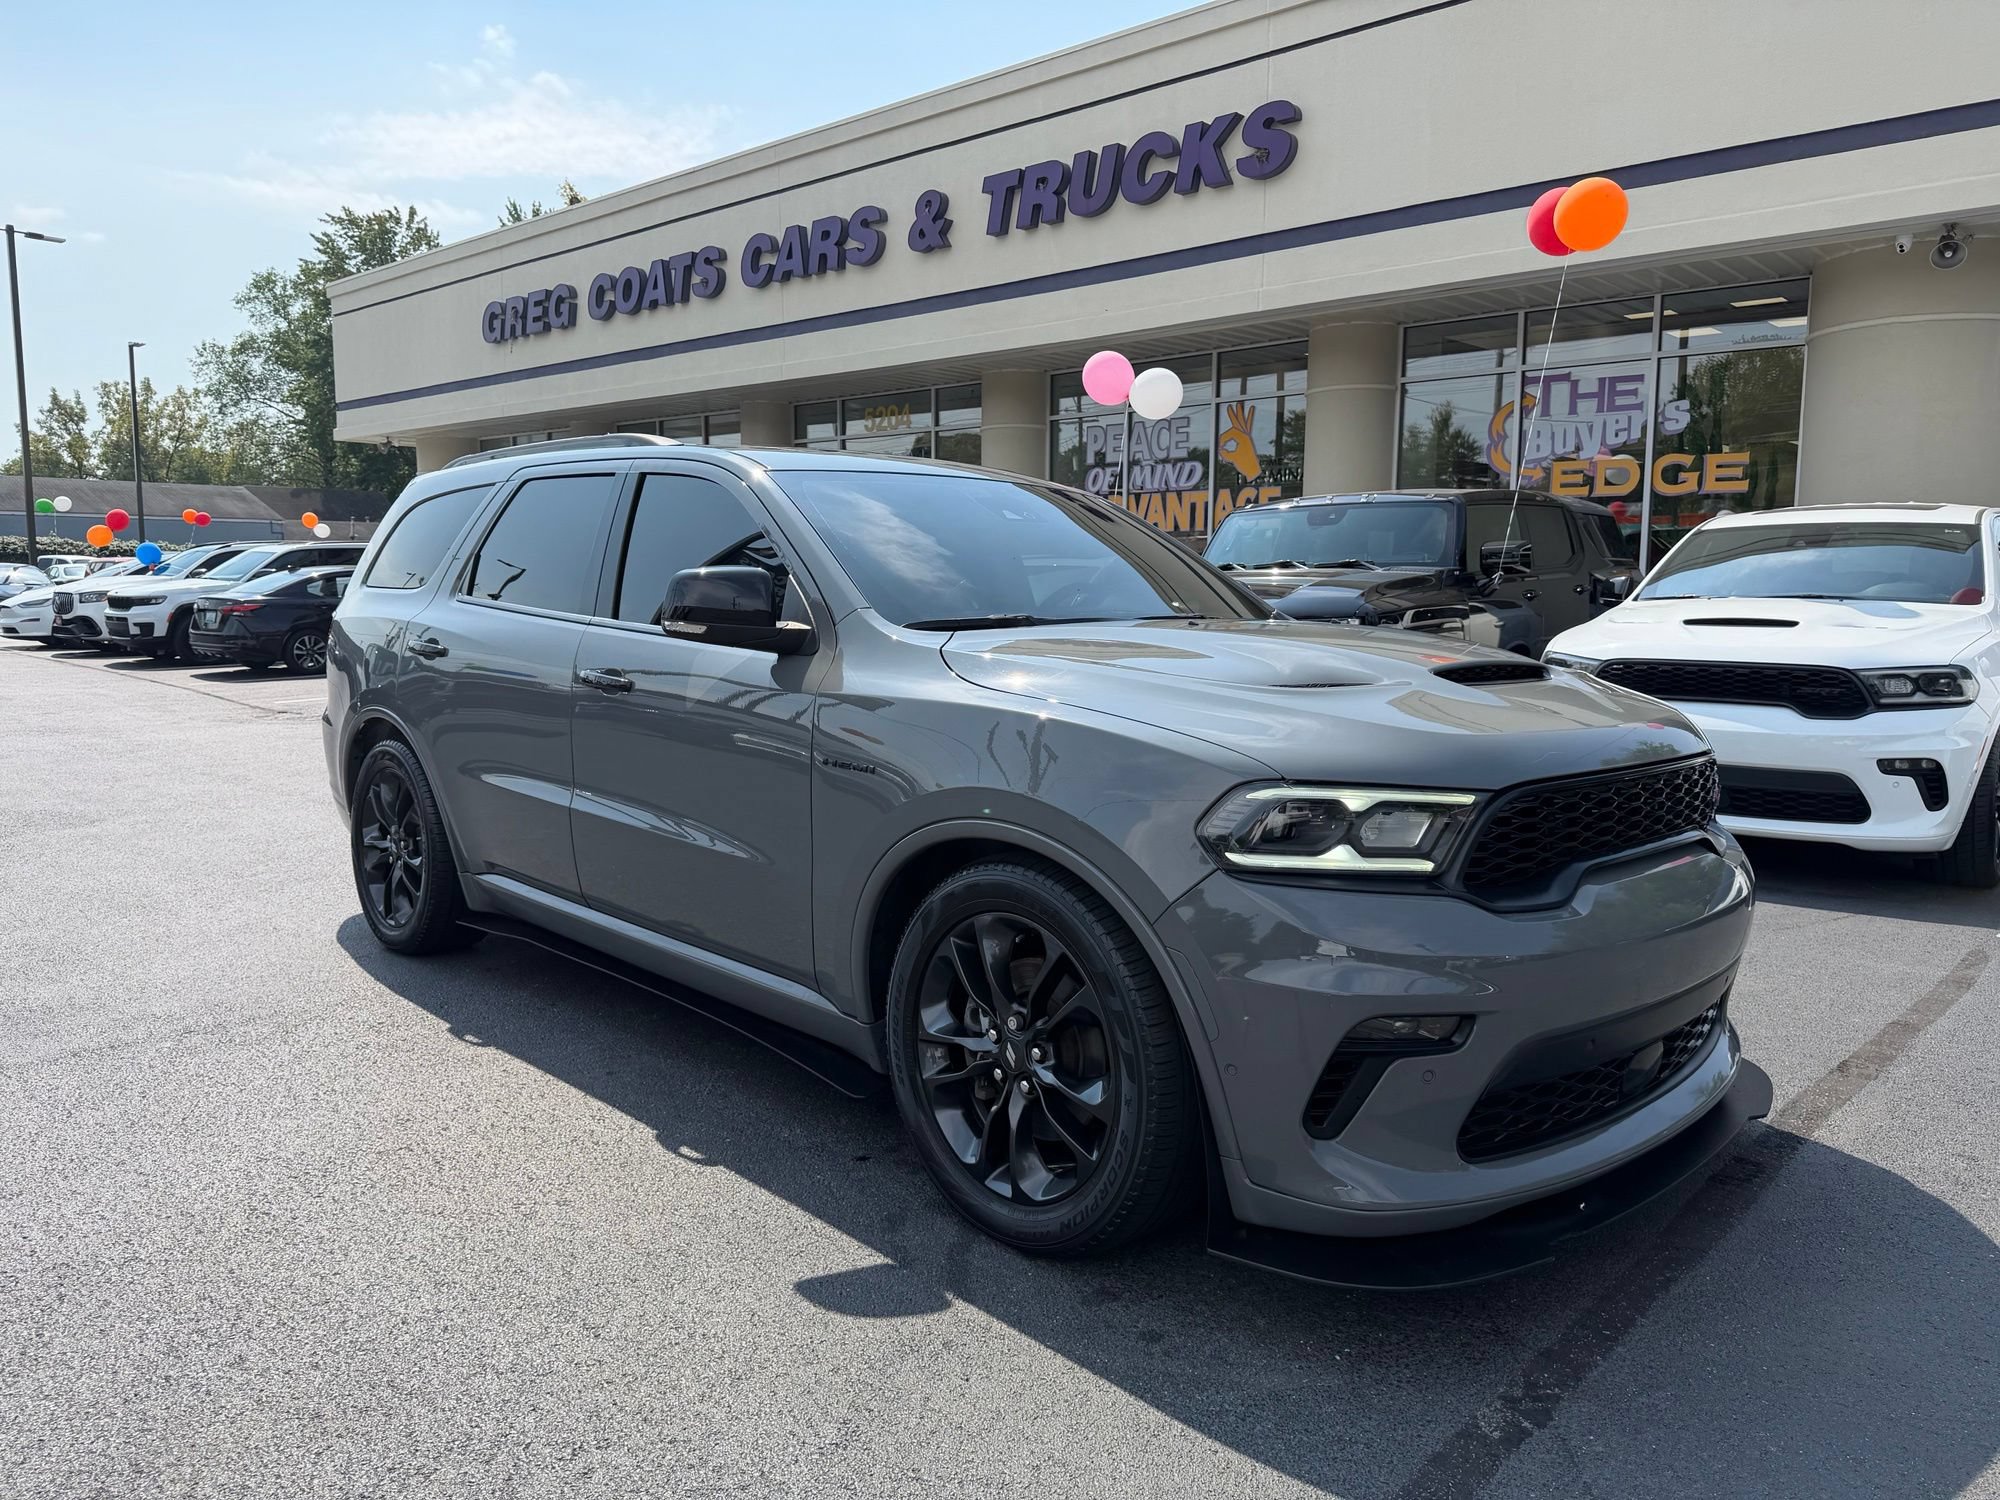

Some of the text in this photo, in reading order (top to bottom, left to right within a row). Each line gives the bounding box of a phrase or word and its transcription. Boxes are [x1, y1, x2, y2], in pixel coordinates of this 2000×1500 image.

[482, 99, 1302, 344] GREG COATS CARS & TRUCKS
[864, 403, 912, 433] 5204
[1524, 371, 1645, 418] THE
[1086, 416, 1190, 466] PEACE
[1084, 466, 1120, 495] OF
[1128, 460, 1204, 494] MIND
[1550, 450, 1751, 497] EDGE
[1108, 485, 1282, 533] VANTA
[1059, 1128, 1130, 1233] SCORPION
